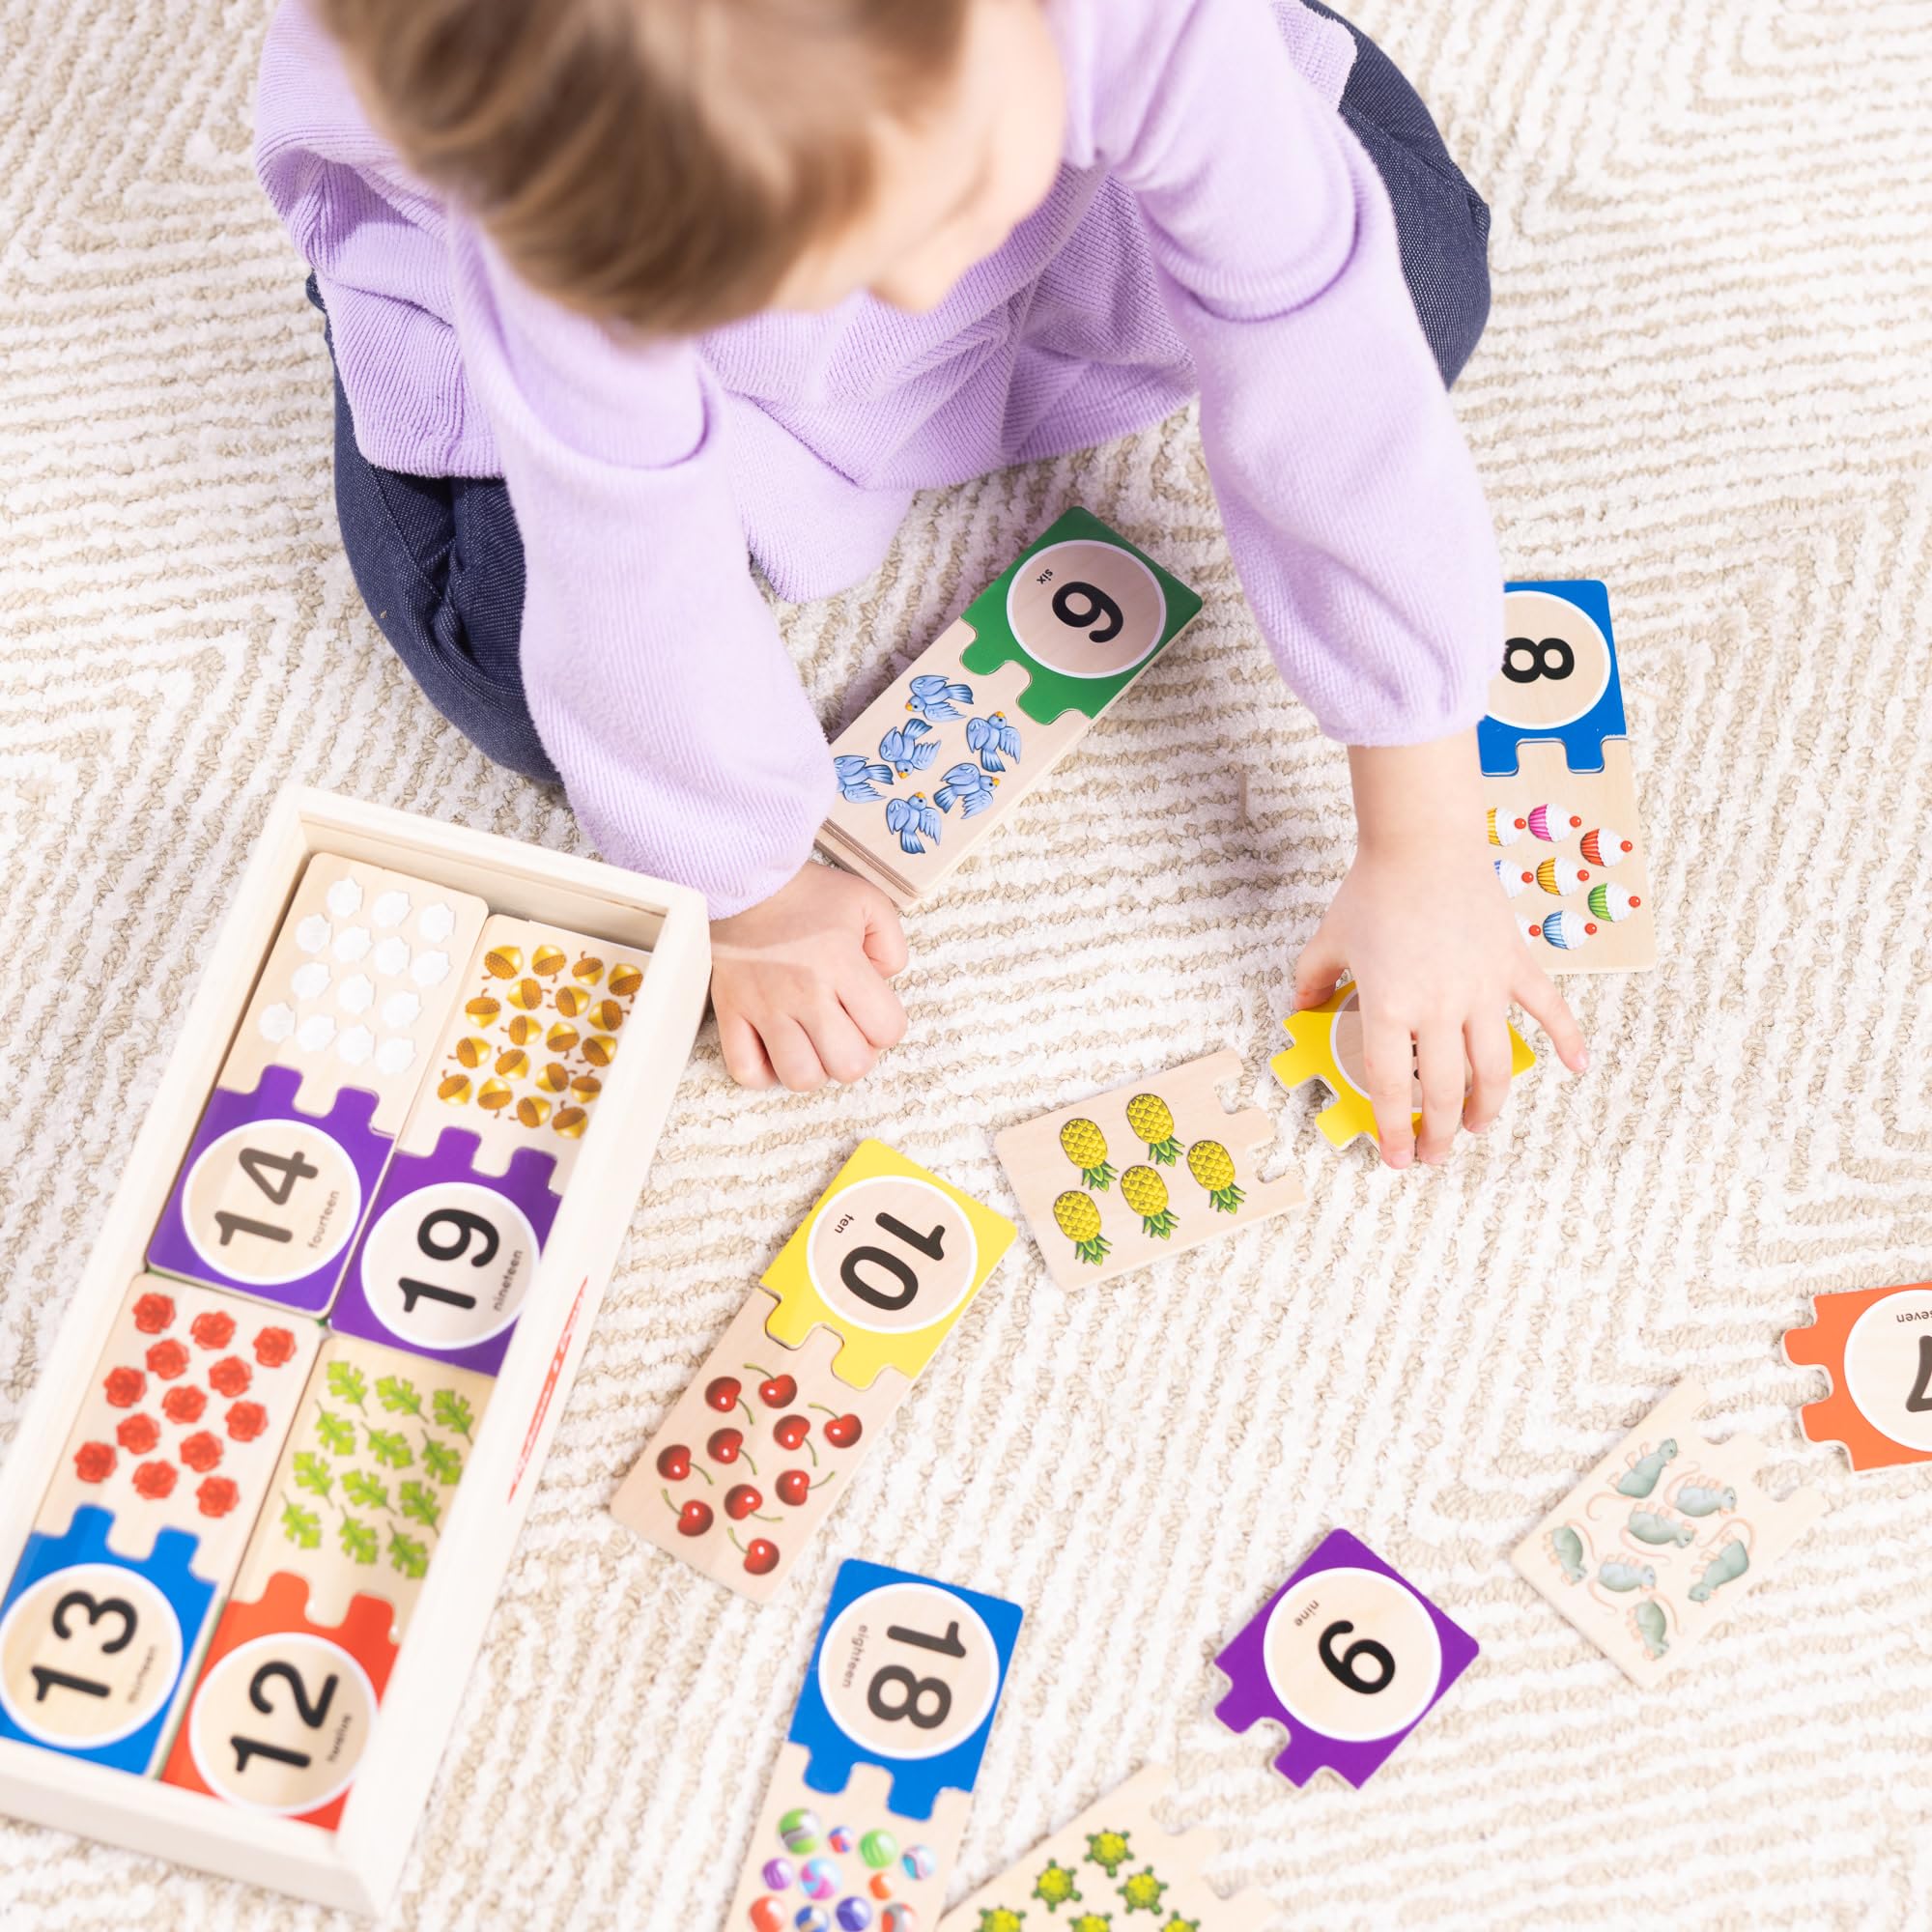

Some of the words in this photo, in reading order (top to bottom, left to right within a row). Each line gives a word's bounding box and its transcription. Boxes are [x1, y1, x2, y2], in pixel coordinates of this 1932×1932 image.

[1037, 568, 1053, 584] six
[1052, 582, 1124, 643] 6
[1501, 638, 1575, 684] 8
[214, 1147, 319, 1247] 14
[307, 1190, 340, 1248] fourteen
[834, 1213, 855, 1234] ten
[397, 1208, 500, 1313] 19
[493, 1250, 524, 1312] nineteen
[840, 1211, 946, 1311] 10
[30, 1590, 138, 1703] 13
[1294, 1600, 1320, 1627] nine
[841, 1624, 867, 1690] eighteen
[867, 1620, 967, 1730] 18
[1318, 1620, 1396, 1695] 9
[230, 1660, 339, 1774] 12
